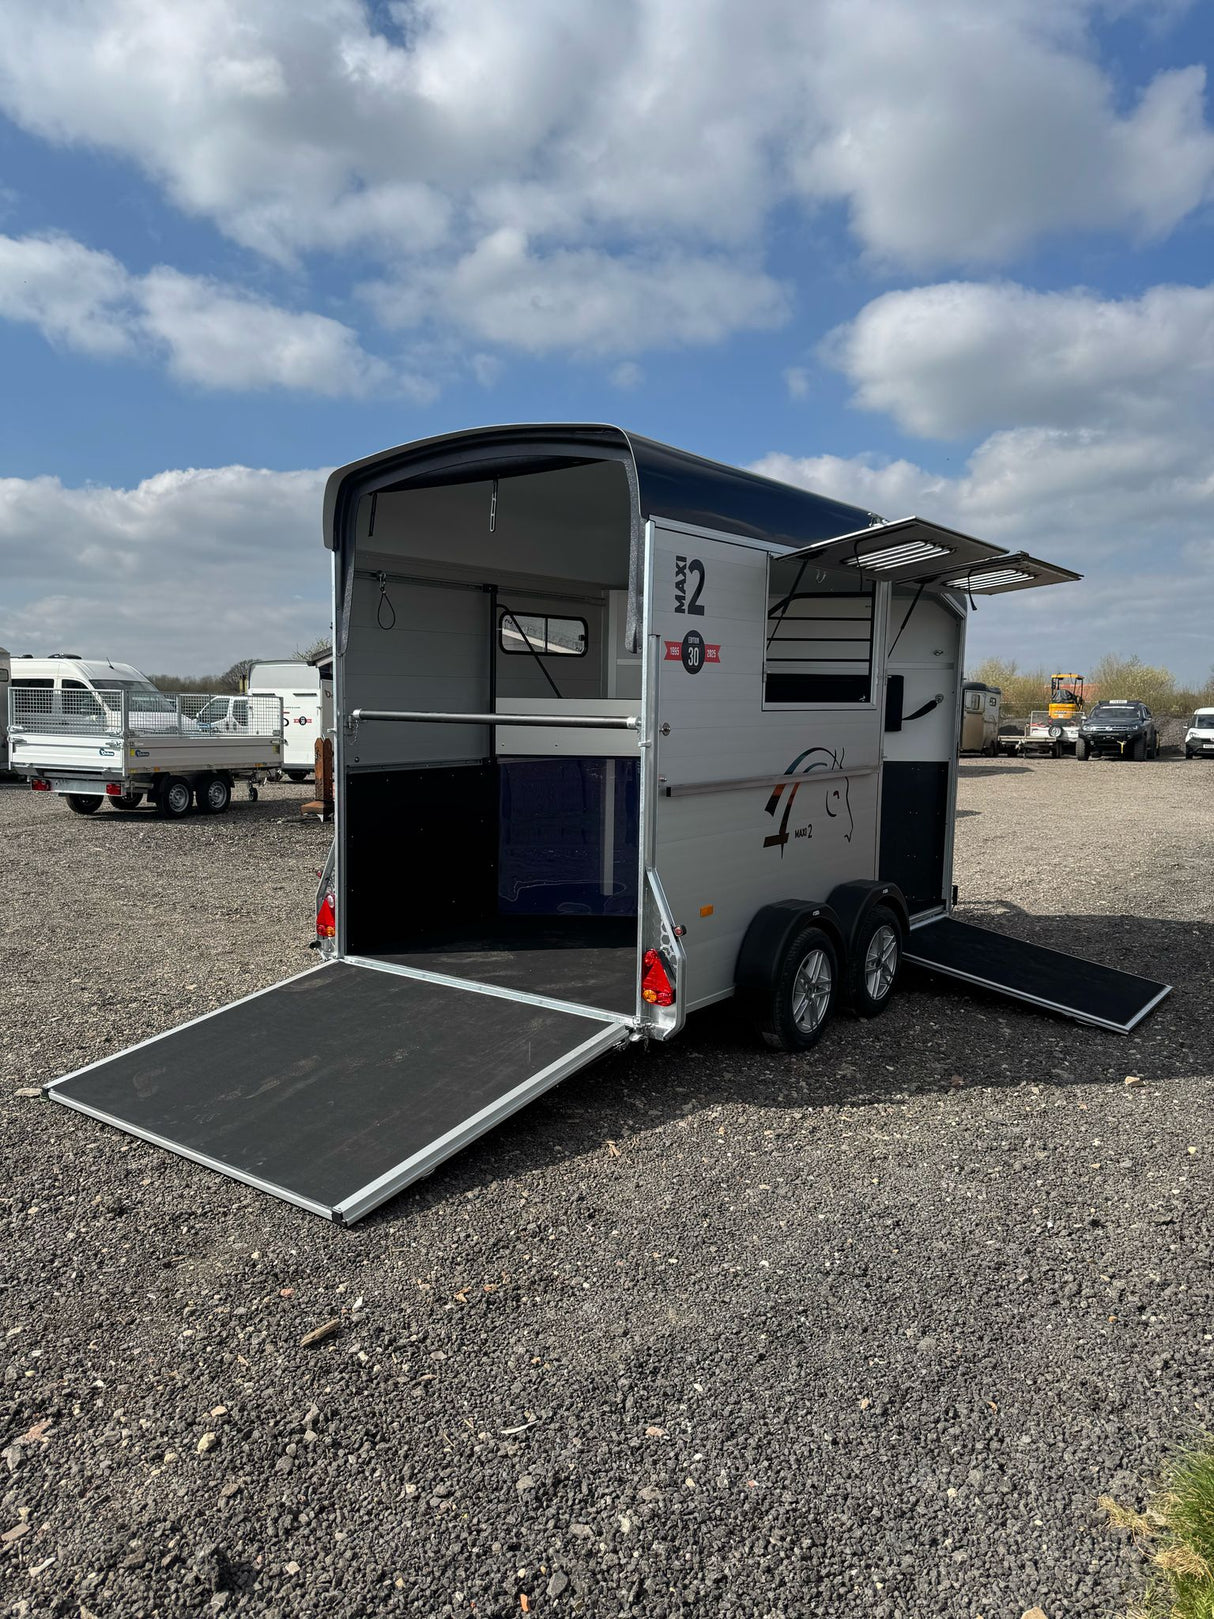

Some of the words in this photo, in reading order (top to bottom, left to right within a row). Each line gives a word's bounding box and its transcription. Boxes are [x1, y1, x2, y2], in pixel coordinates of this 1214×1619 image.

[675, 556, 687, 613] MAXI
[688, 559, 705, 615] 2
[670, 647, 679, 655] 1995
[688, 647, 699, 666] 30
[707, 649, 716, 658] 2025
[808, 824, 812, 838] 2
